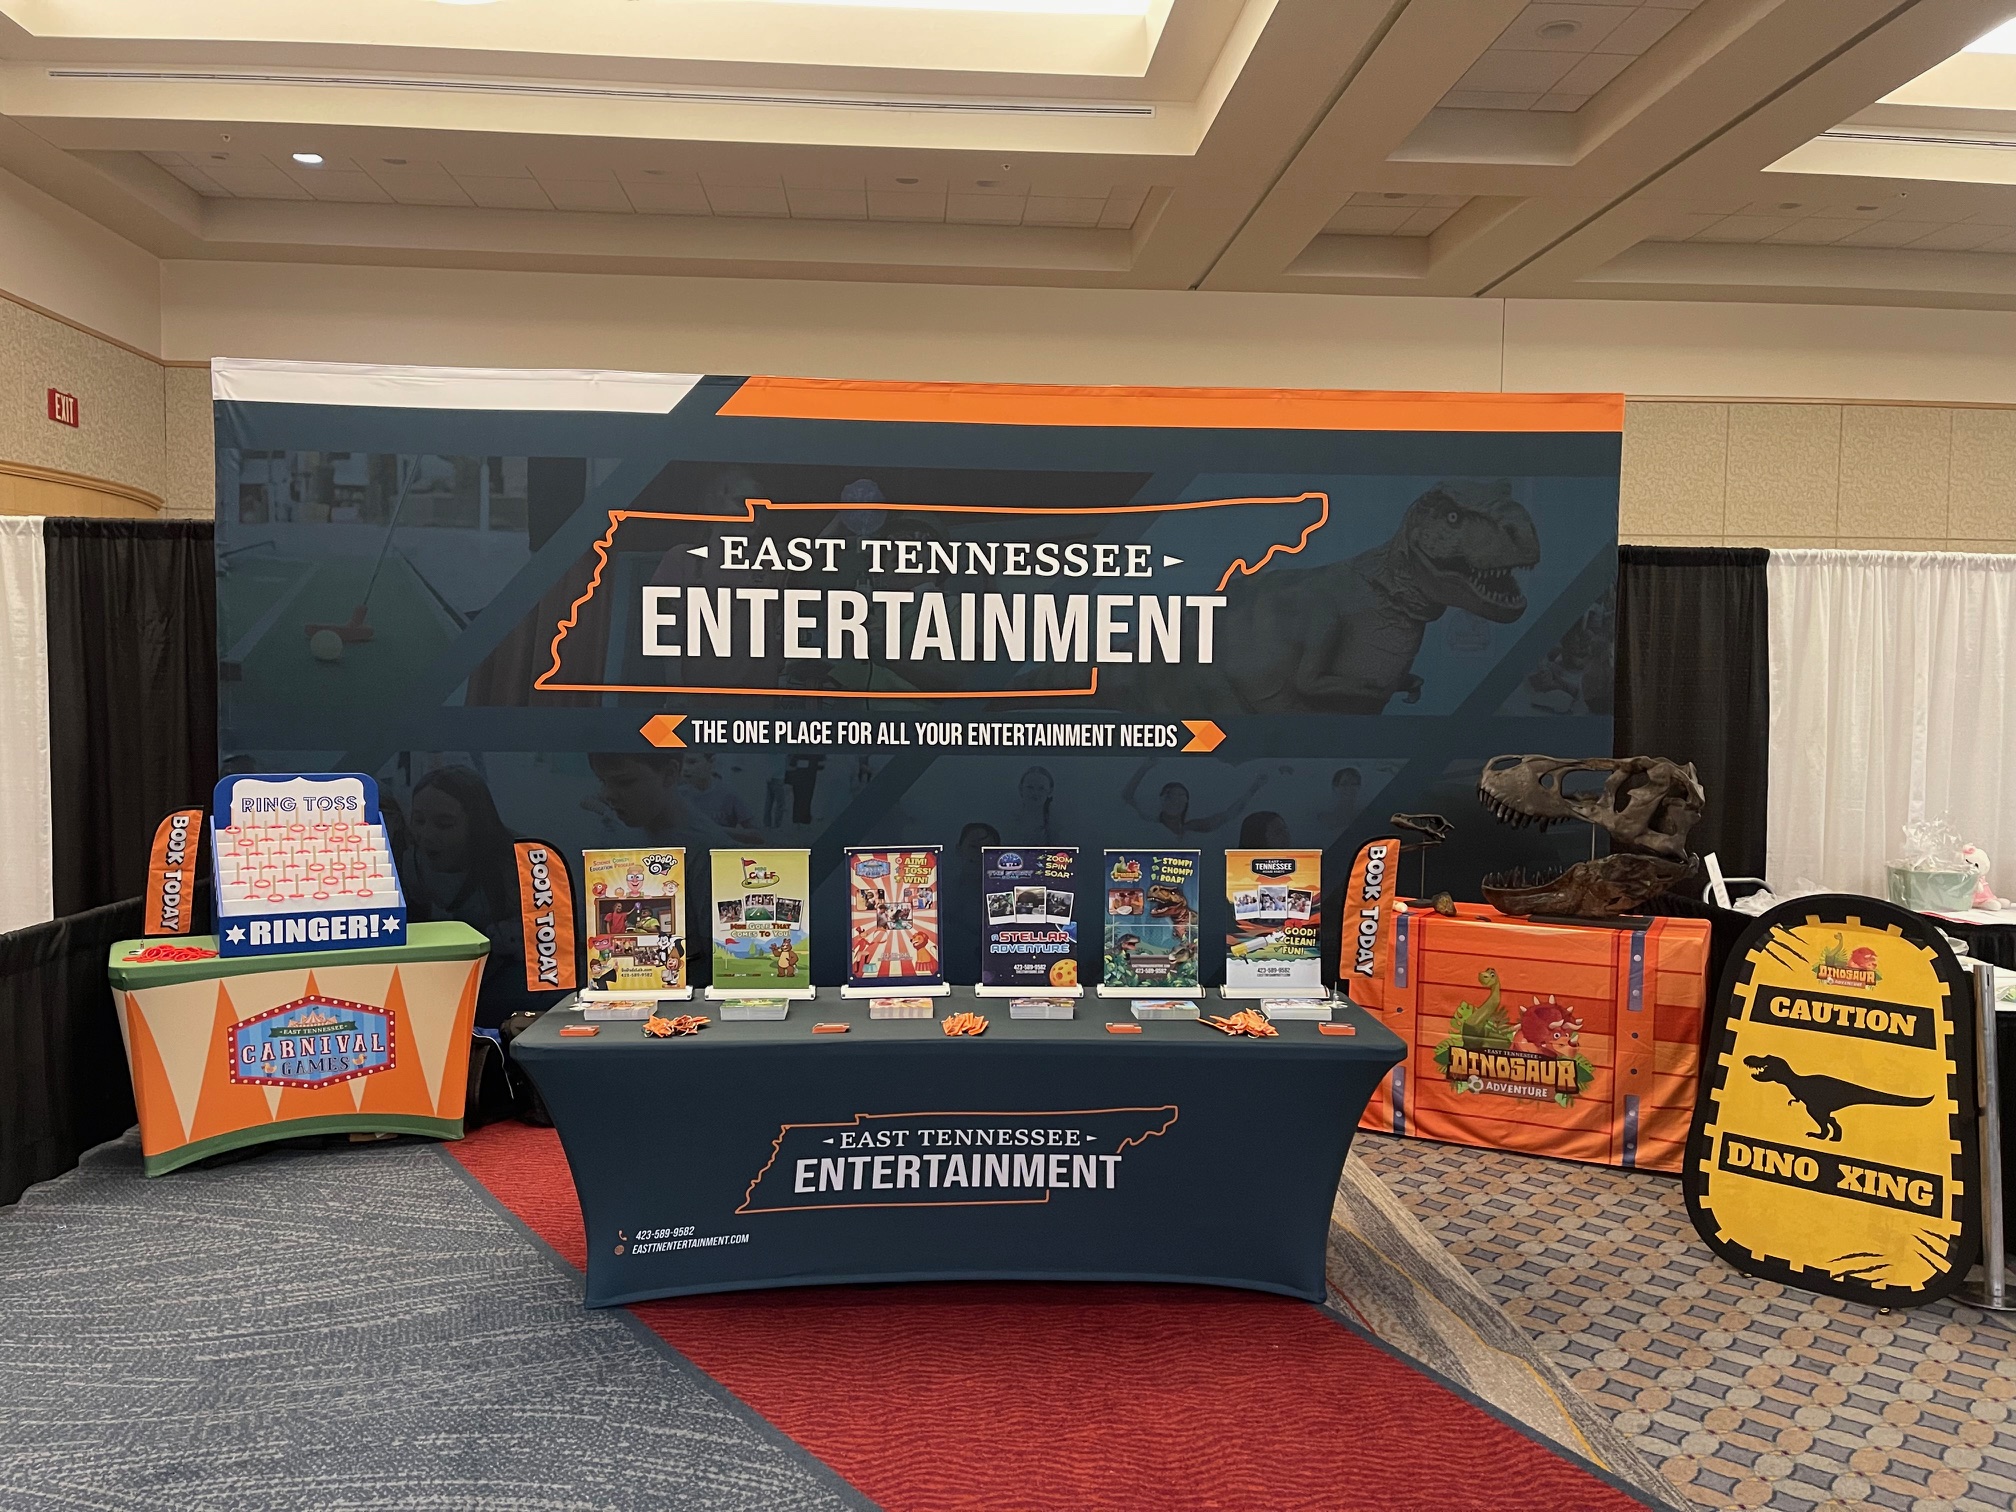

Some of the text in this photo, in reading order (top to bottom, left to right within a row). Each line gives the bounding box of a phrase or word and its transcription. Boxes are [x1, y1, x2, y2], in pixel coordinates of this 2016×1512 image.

[55, 392, 74, 424] EXIT
[720, 535, 1153, 578] EAST TENNESSEE
[641, 585, 1228, 665] ENTERTAINMENT
[691, 720, 1178, 748] THE ONE PLACE FOR ALL YOUR ENTERTAINMENT NEEDS
[242, 796, 357, 813] RING TOSS
[904, 858, 927, 866] AIM!
[1045, 862, 1067, 870] SPIN
[1046, 854, 1073, 864] ZOOM
[1162, 857, 1193, 868] STOMP!
[1255, 863, 1292, 871] TENNESSEE
[161, 816, 190, 931] BOOK TODAY
[904, 867, 931, 875] TOSS!
[1044, 870, 1070, 879] SOAR
[1160, 874, 1185, 884] ROAR!
[1161, 866, 1194, 876] CHOMP!
[903, 876, 928, 884] WIN!
[529, 849, 558, 987] BOOK TODAY
[1355, 845, 1387, 977] BOOK TODAY
[249, 914, 379, 946] RINGER!
[730, 930, 757, 938] COMES
[759, 930, 771, 938] TO
[999, 931, 1069, 943] STELLAR
[1284, 927, 1317, 937] GOOD!
[990, 942, 1070, 954] ADVENTURE
[1283, 936, 1316, 947] CLEAN!
[1282, 946, 1305, 956] FUN!
[1818, 965, 1876, 984] DINOSAUR
[1769, 996, 1917, 1037] CAUTION
[303, 1024, 344, 1035] TENNESSEE
[241, 1033, 385, 1065] CARNIVAL
[1503, 1050, 1538, 1059] TENNESSEE
[281, 1056, 351, 1076] GAMES
[1449, 1046, 1577, 1088] DINOSAUR
[1486, 1081, 1548, 1098] ADVENTURE
[840, 1128, 1082, 1149] EAST TENNESSEE
[794, 1153, 1122, 1194] ENTERTAINMENT
[1727, 1140, 1934, 1207] DINO XING
[635, 1226, 695, 1241] 423-589-9582
[632, 1234, 750, 1255] EASTTNENTERTAINMENT.COM
